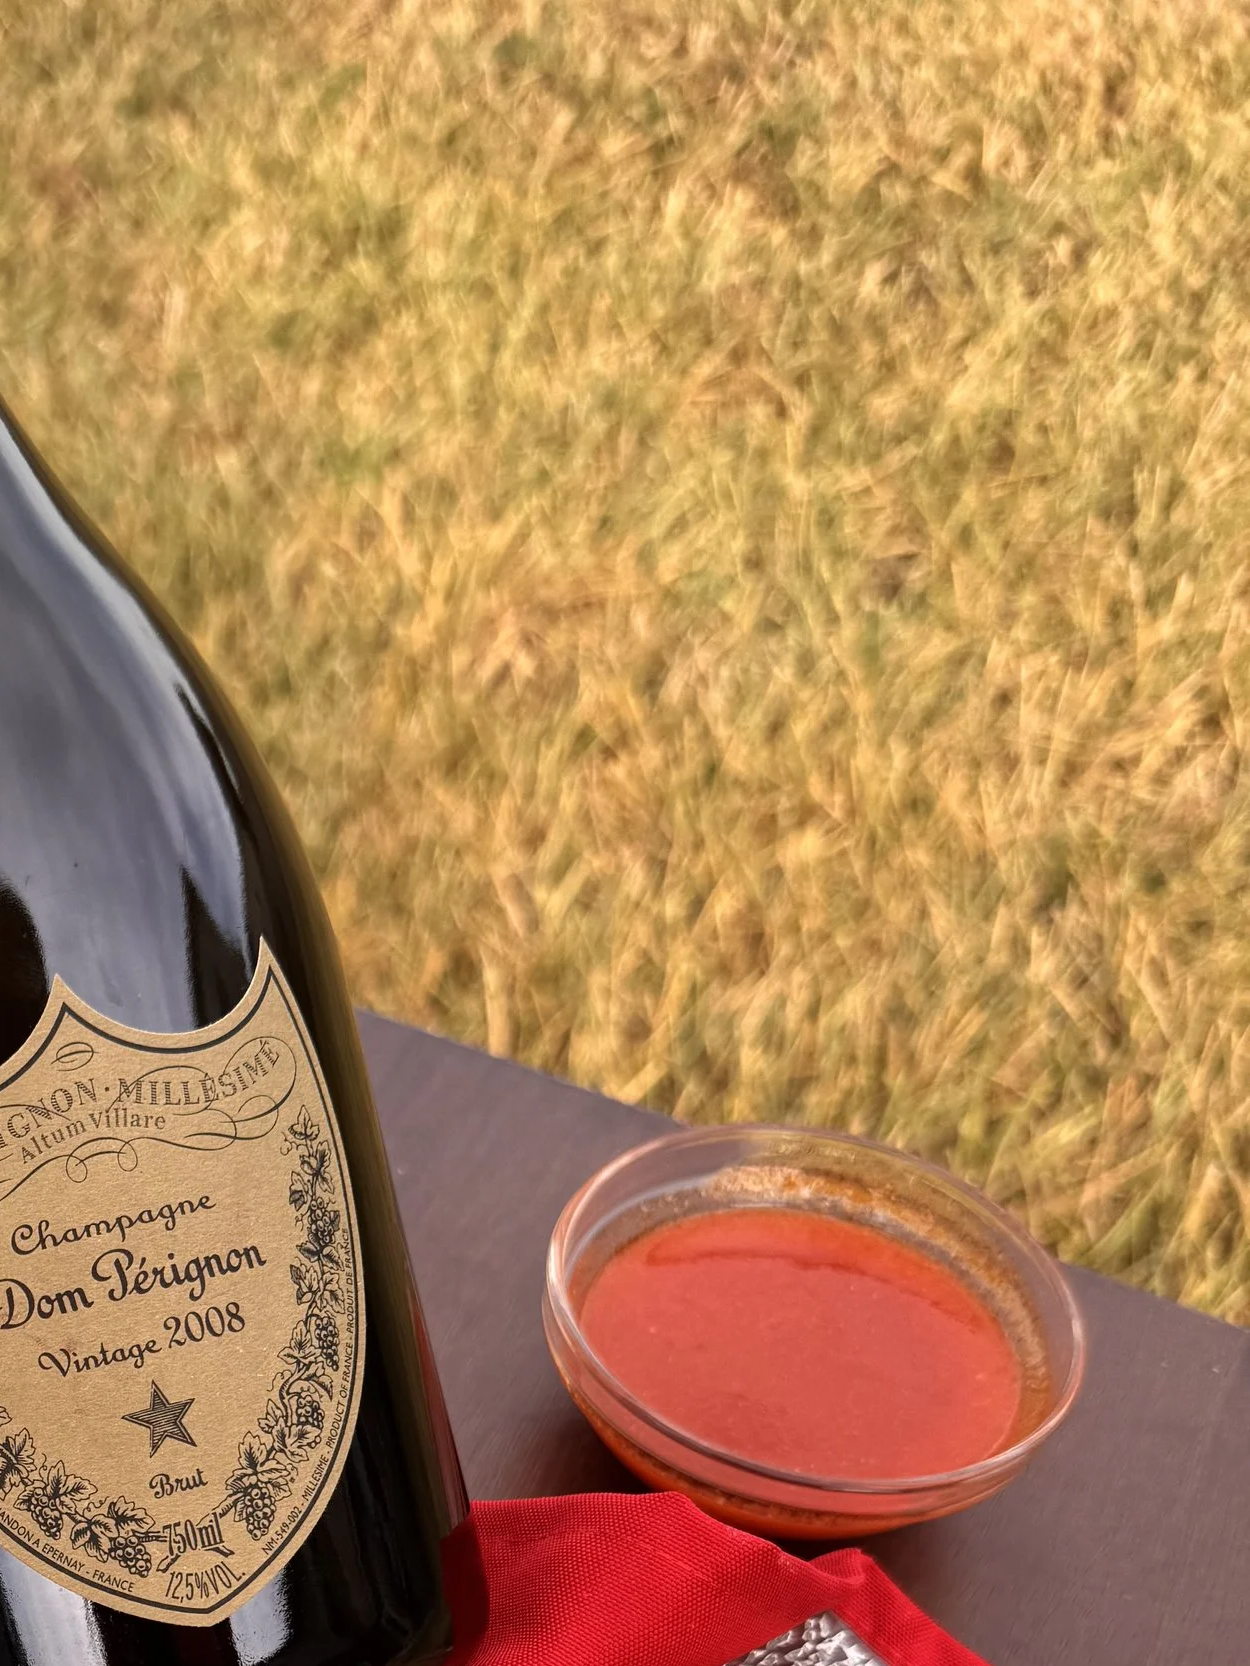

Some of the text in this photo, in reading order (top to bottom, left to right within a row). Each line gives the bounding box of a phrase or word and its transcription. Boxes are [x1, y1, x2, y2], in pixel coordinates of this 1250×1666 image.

[21, 1107, 166, 1164] Altum Villare
[11, 1195, 217, 1256] Champagne
[342, 1228, 353, 1270] FRANCE
[91, 1245, 267, 1302] Pérignon
[345, 1271, 353, 1285] DE
[346, 1287, 355, 1334] PRODUIT
[38, 1302, 246, 1377] Vintage 2008
[342, 1342, 354, 1383] FRANCE
[339, 1384, 350, 1399] OF
[325, 1401, 346, 1449] PRODUCT
[149, 1468, 208, 1499] Brut
[301, 1454, 330, 1502] MILLESIME
[162, 1511, 225, 1557] 750ml
[261, 1506, 303, 1556] NM-549-002
[41, 1542, 86, 1574] EPERNAY
[92, 1569, 135, 1593] FRANCE
